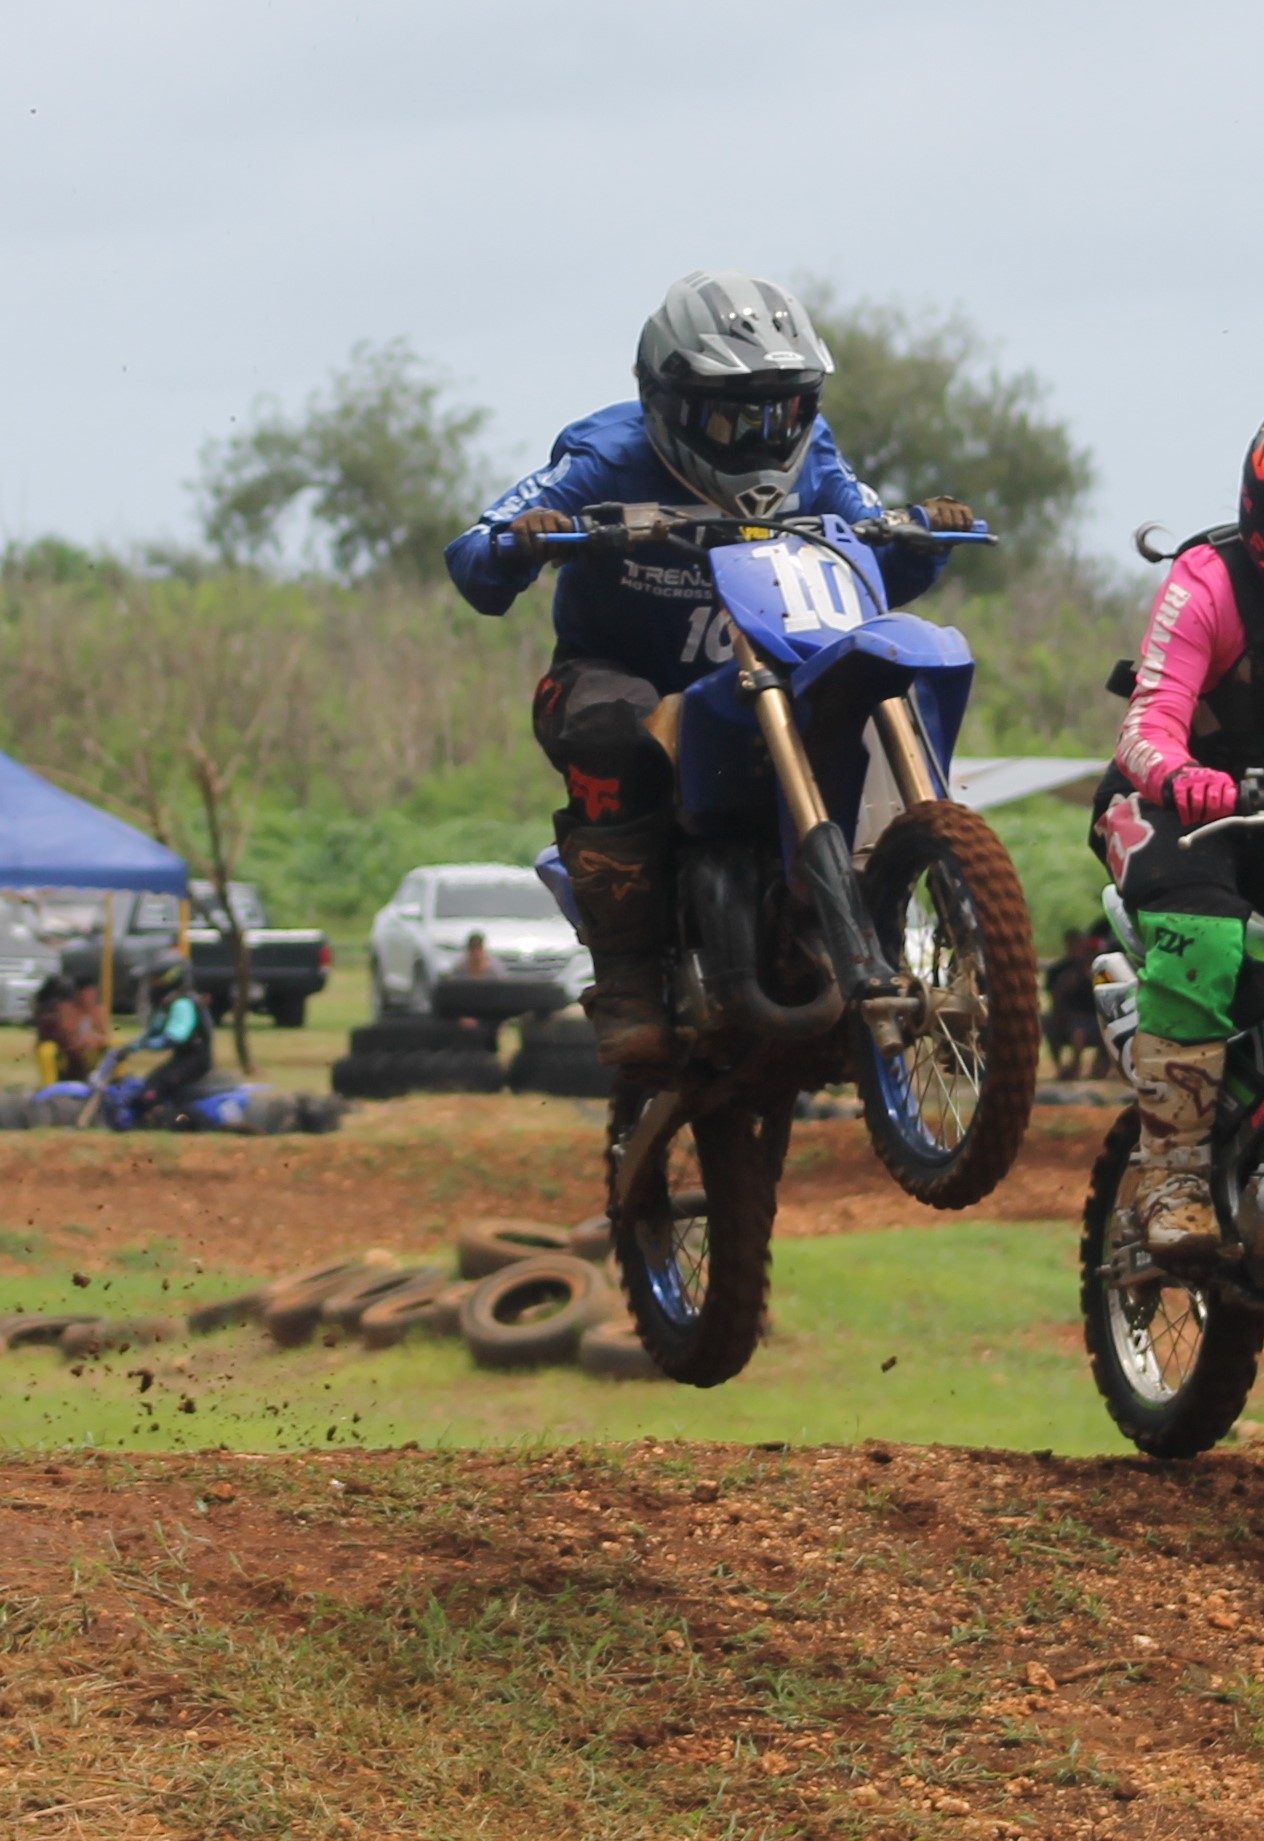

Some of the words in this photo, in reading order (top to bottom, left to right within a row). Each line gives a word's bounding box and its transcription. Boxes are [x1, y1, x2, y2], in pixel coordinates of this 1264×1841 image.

[623, 559, 713, 587] TREN
[620, 577, 713, 600] MOTOCROSS
[751, 543, 863, 633] 10
